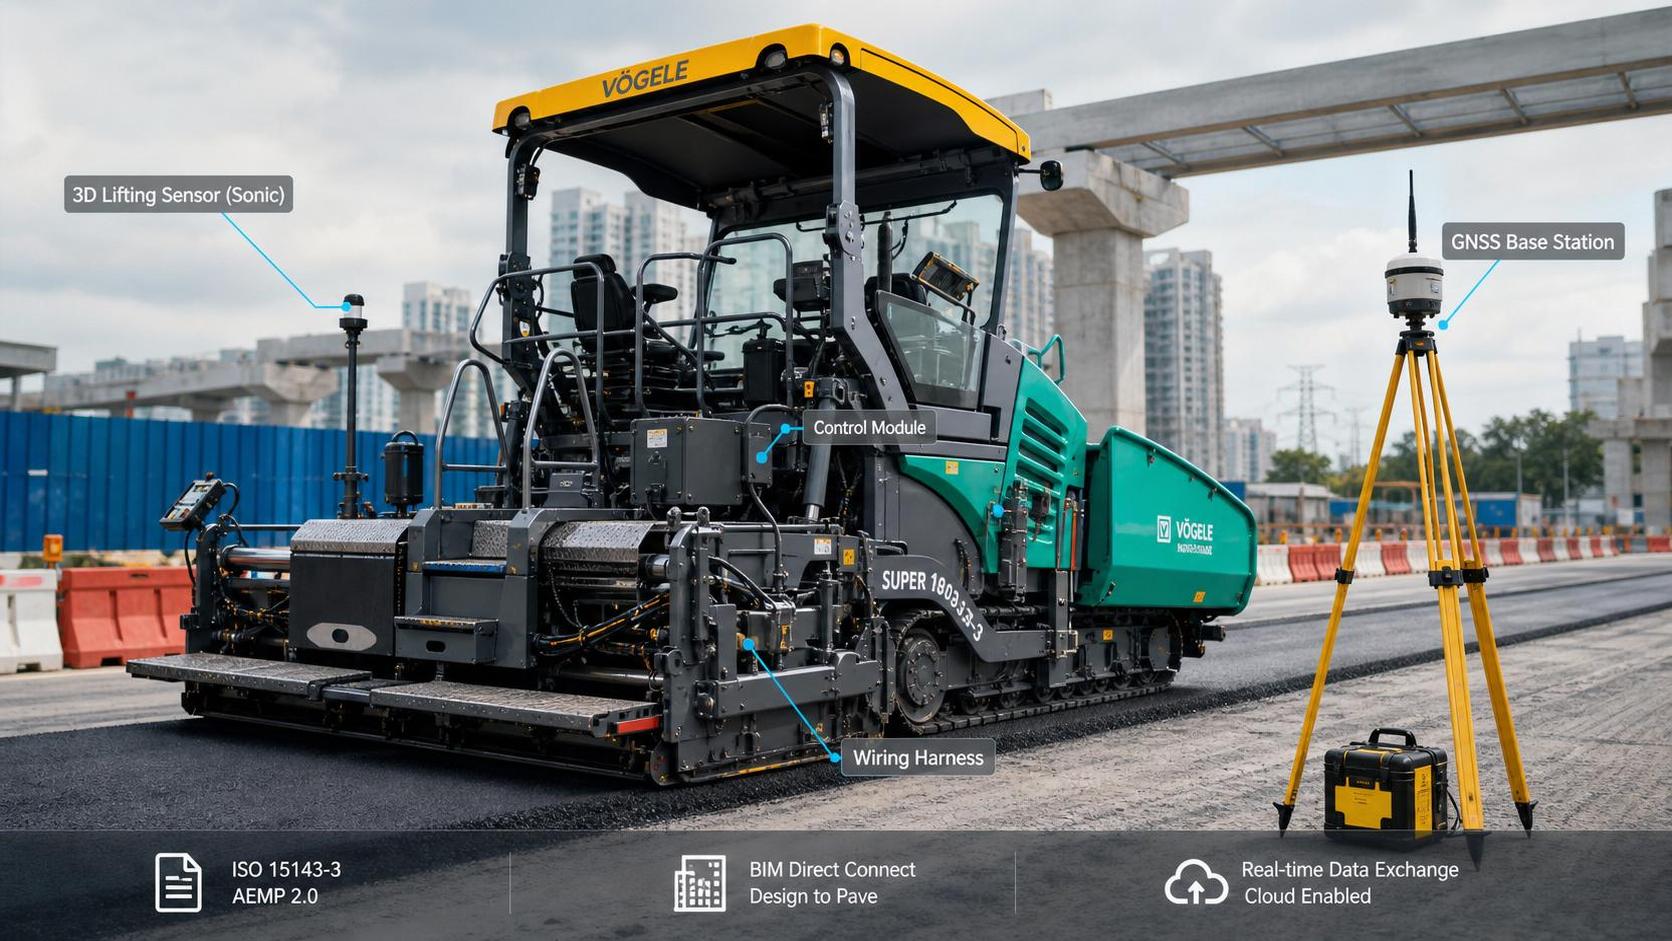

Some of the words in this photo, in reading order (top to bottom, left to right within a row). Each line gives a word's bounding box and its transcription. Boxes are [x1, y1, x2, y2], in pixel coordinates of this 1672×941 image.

[602, 59, 689, 98] VÖGELE
[1176, 517, 1214, 542] VÖGELE
[881, 570, 927, 591] SUPER
